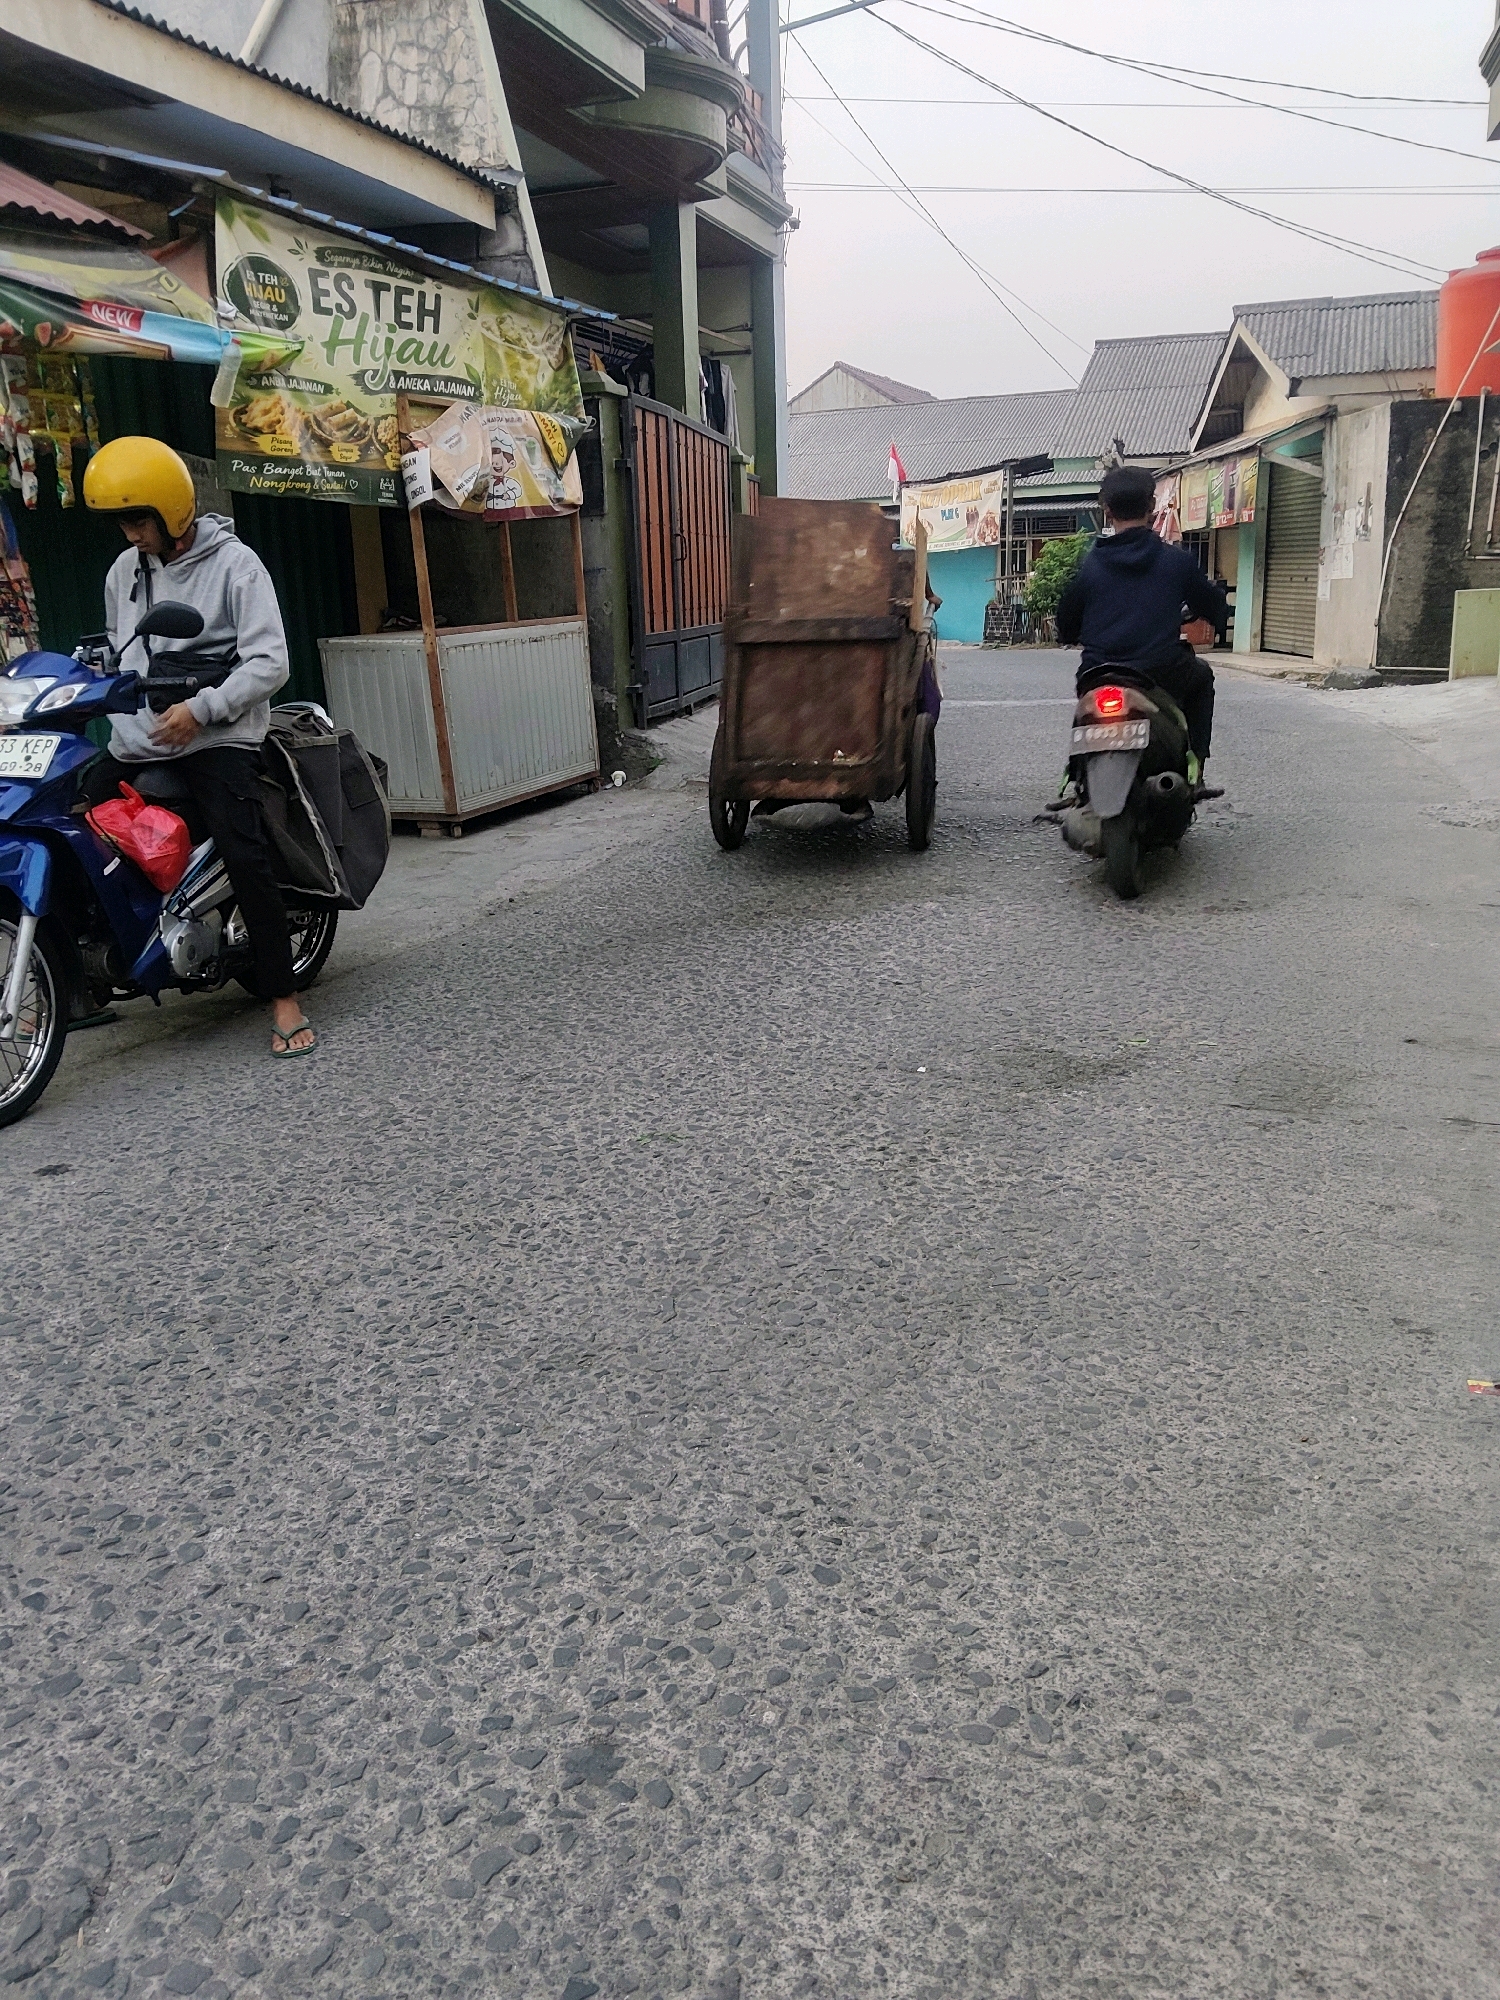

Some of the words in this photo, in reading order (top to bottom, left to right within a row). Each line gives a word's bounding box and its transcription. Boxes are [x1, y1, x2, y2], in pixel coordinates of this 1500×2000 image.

[324, 249, 360, 267] Segarnya
[257, 272, 278, 286] TEH
[245, 282, 286, 304] HIJAU
[307, 267, 358, 320] ES
[364, 278, 442, 335] TEH
[91, 302, 134, 328] NEW
[320, 311, 457, 391] Hijau
[287, 379, 325, 394] JAJANAN
[389, 375, 396, 389] &
[397, 377, 431, 391] ANEKA
[433, 380, 475, 397] JAJANAN
[494, 386, 523, 408] Hijau
[270, 436, 293, 447] Pisang
[270, 445, 294, 454] Goreng
[231, 459, 258, 474] Pas
[262, 462, 303, 480] Banget
[322, 466, 346, 478] Teman
[249, 475, 311, 494] Nongkrong
[20, 738, 54, 754] KEP
